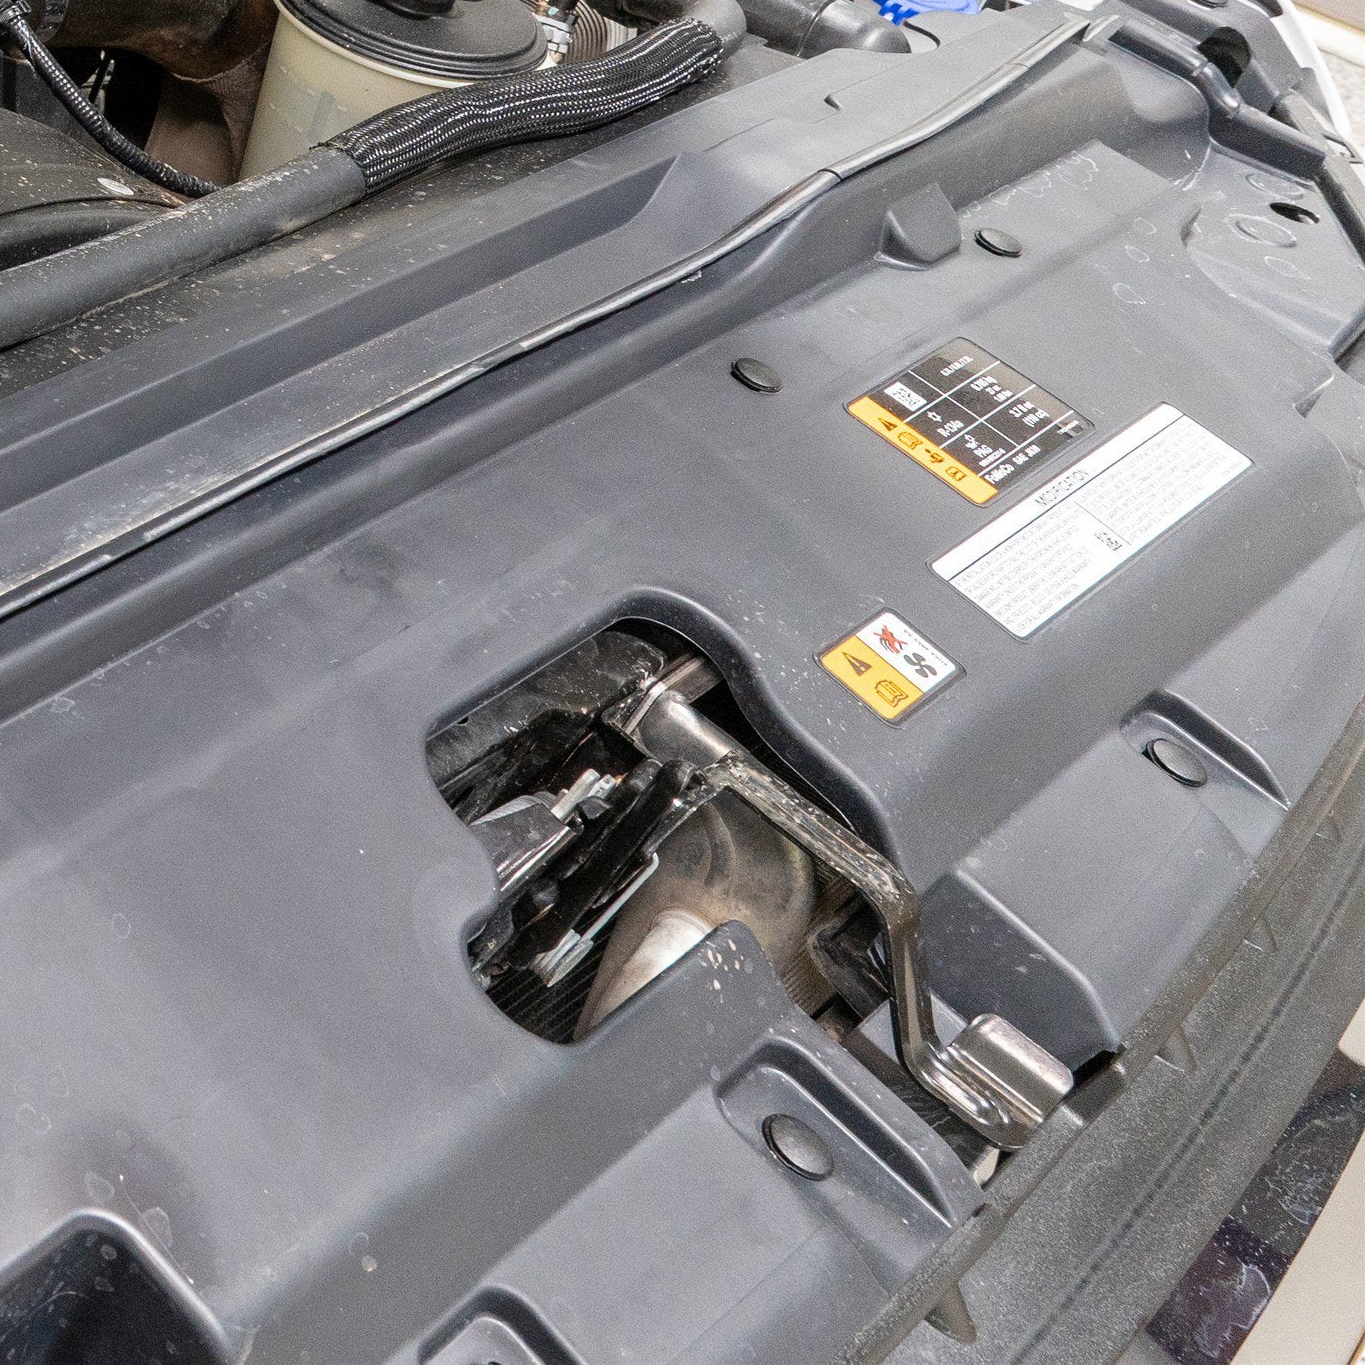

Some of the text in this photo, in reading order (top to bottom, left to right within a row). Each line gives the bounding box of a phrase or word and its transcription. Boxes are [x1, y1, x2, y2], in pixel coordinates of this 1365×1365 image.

[937, 419, 964, 436] R-134a
[973, 445, 993, 457] PAG
[984, 463, 1016, 483] FoMoCo
[1035, 469, 1090, 508] MODIFICATION
